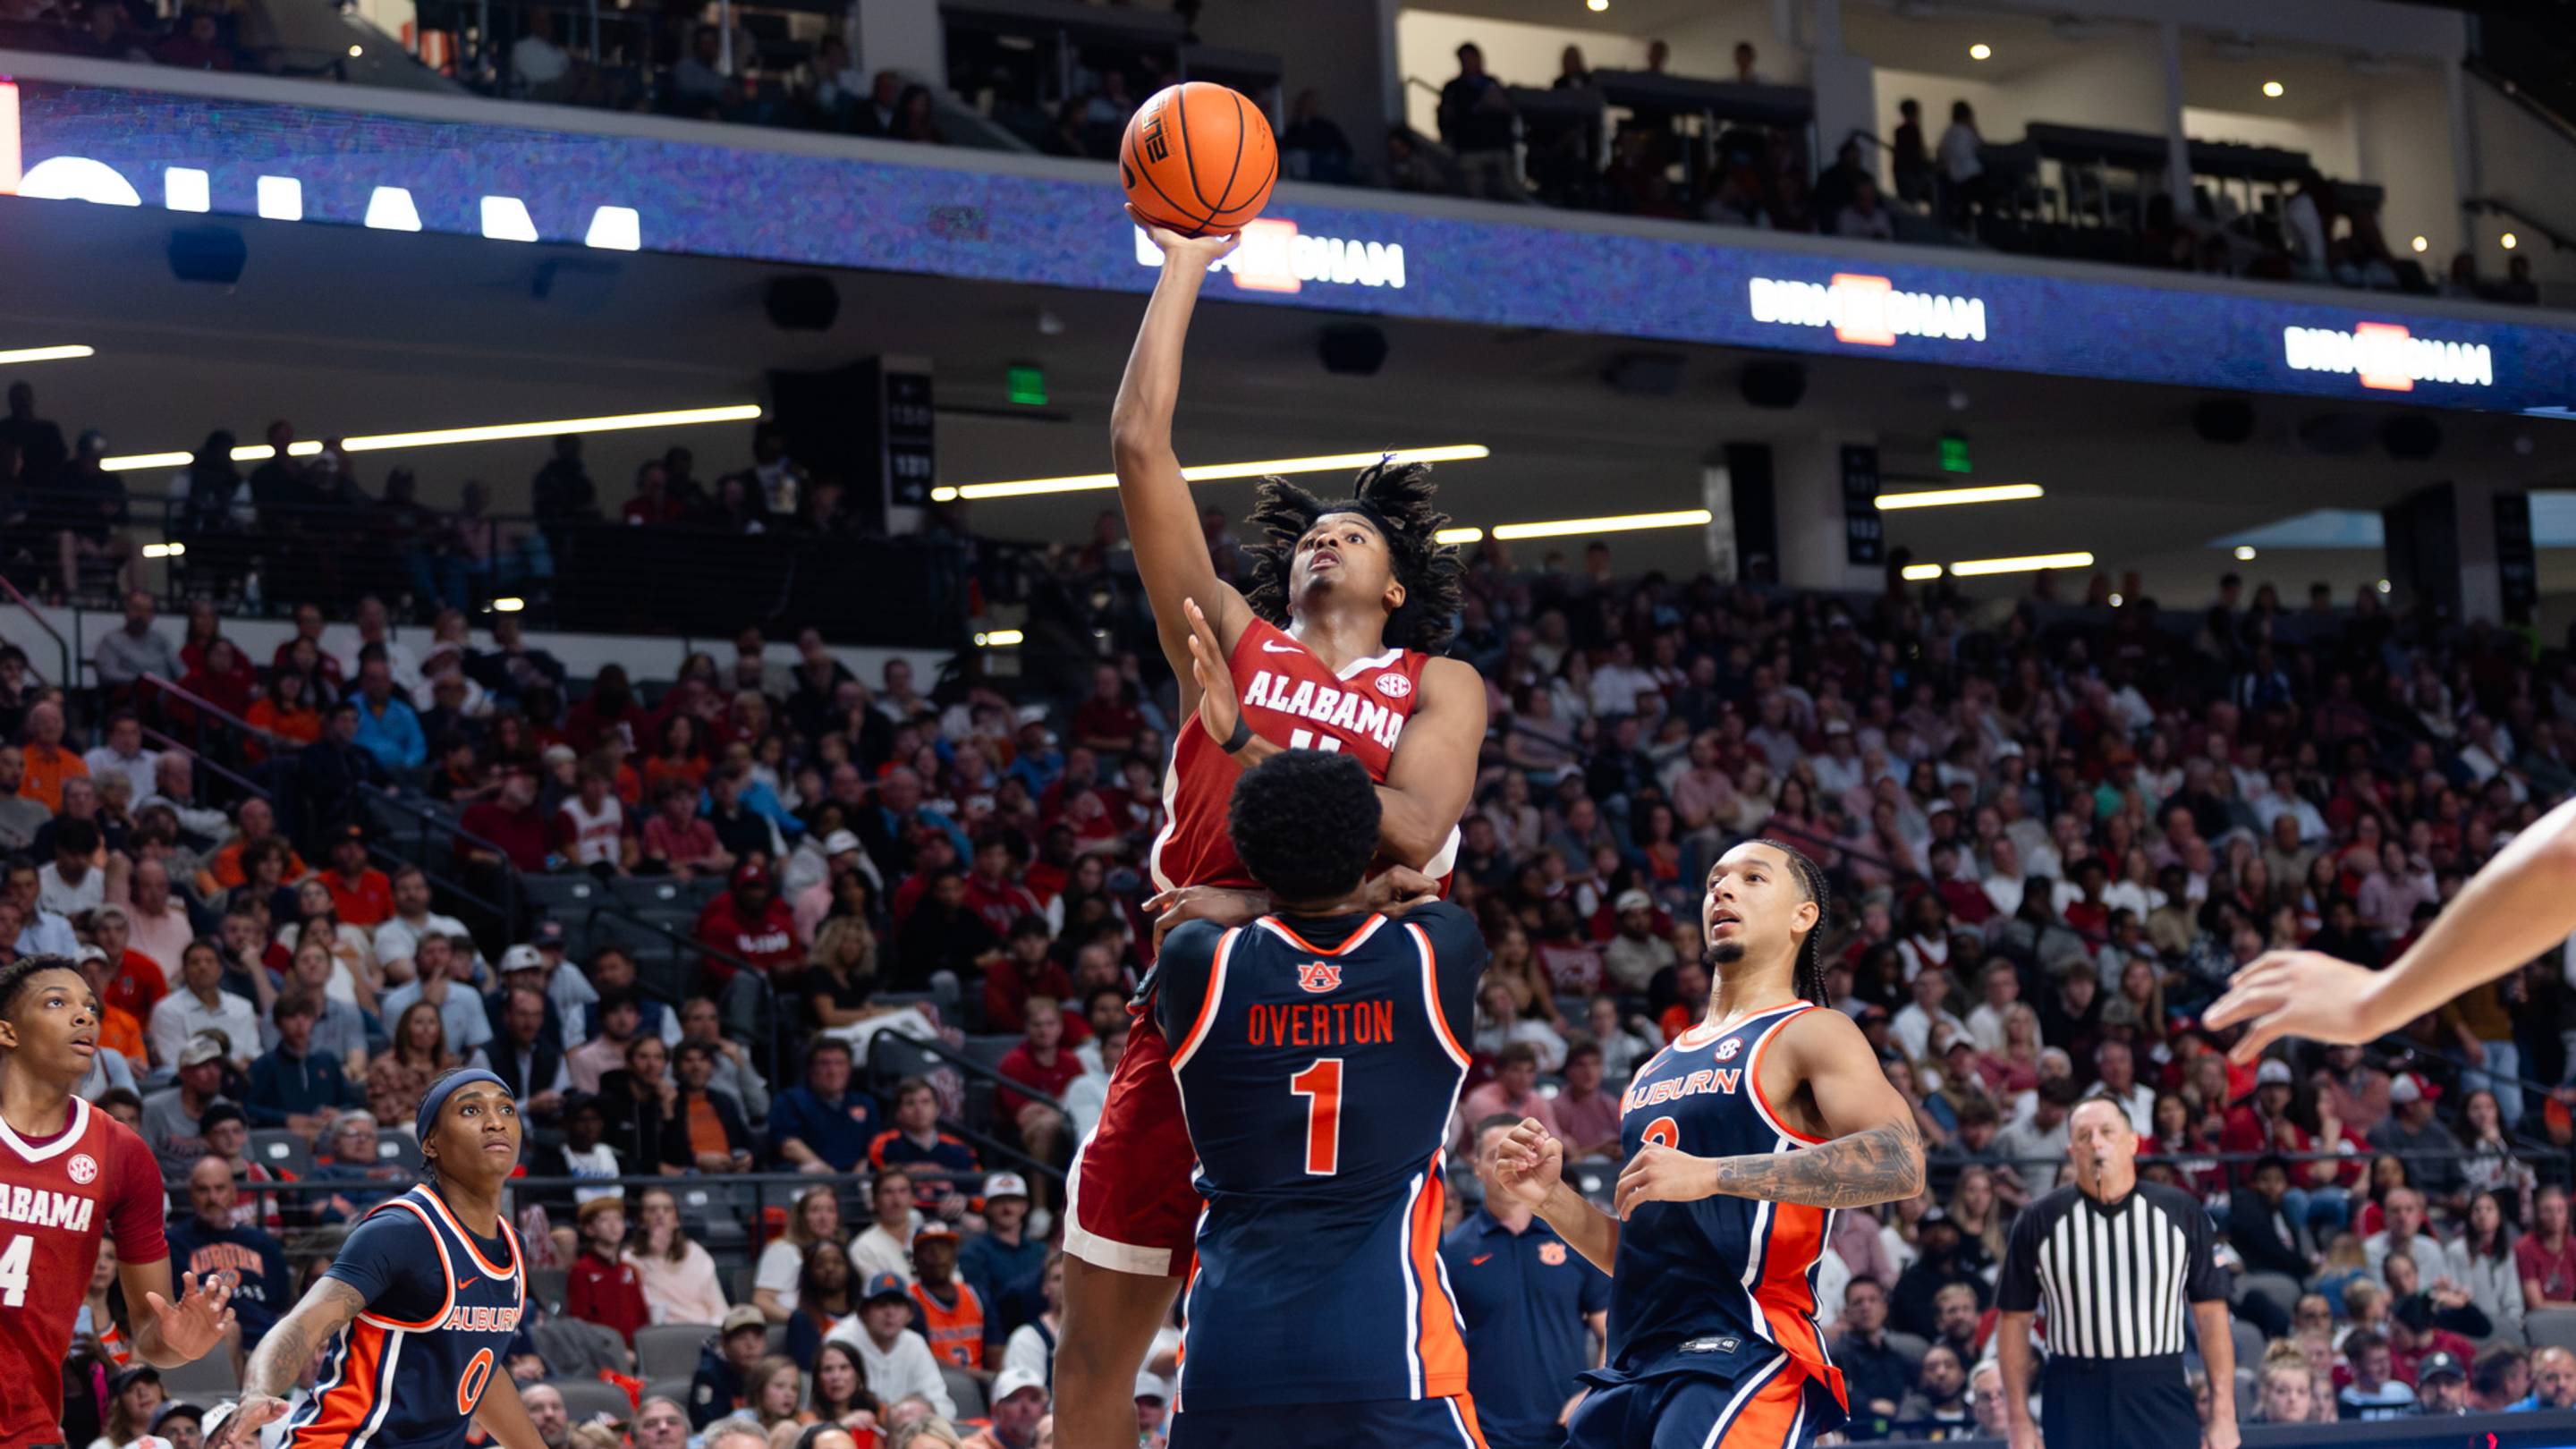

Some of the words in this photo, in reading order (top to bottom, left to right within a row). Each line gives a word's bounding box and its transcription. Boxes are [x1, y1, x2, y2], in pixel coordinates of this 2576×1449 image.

[1750, 276, 1986, 342] BIRMGHAM
[2284, 326, 2493, 386] BIRMGHAM
[1243, 670, 1404, 752] ALABAMA
[1377, 675, 1409, 697] SEC
[1248, 1000, 1394, 1046] OVERTON
[1290, 1057, 1343, 1176] 1
[1623, 1068, 1742, 1114] AUBURN
[70, 1156, 96, 1182] SEC
[443, 1305, 520, 1332] AUBUR
[457, 1347, 495, 1416] 0
